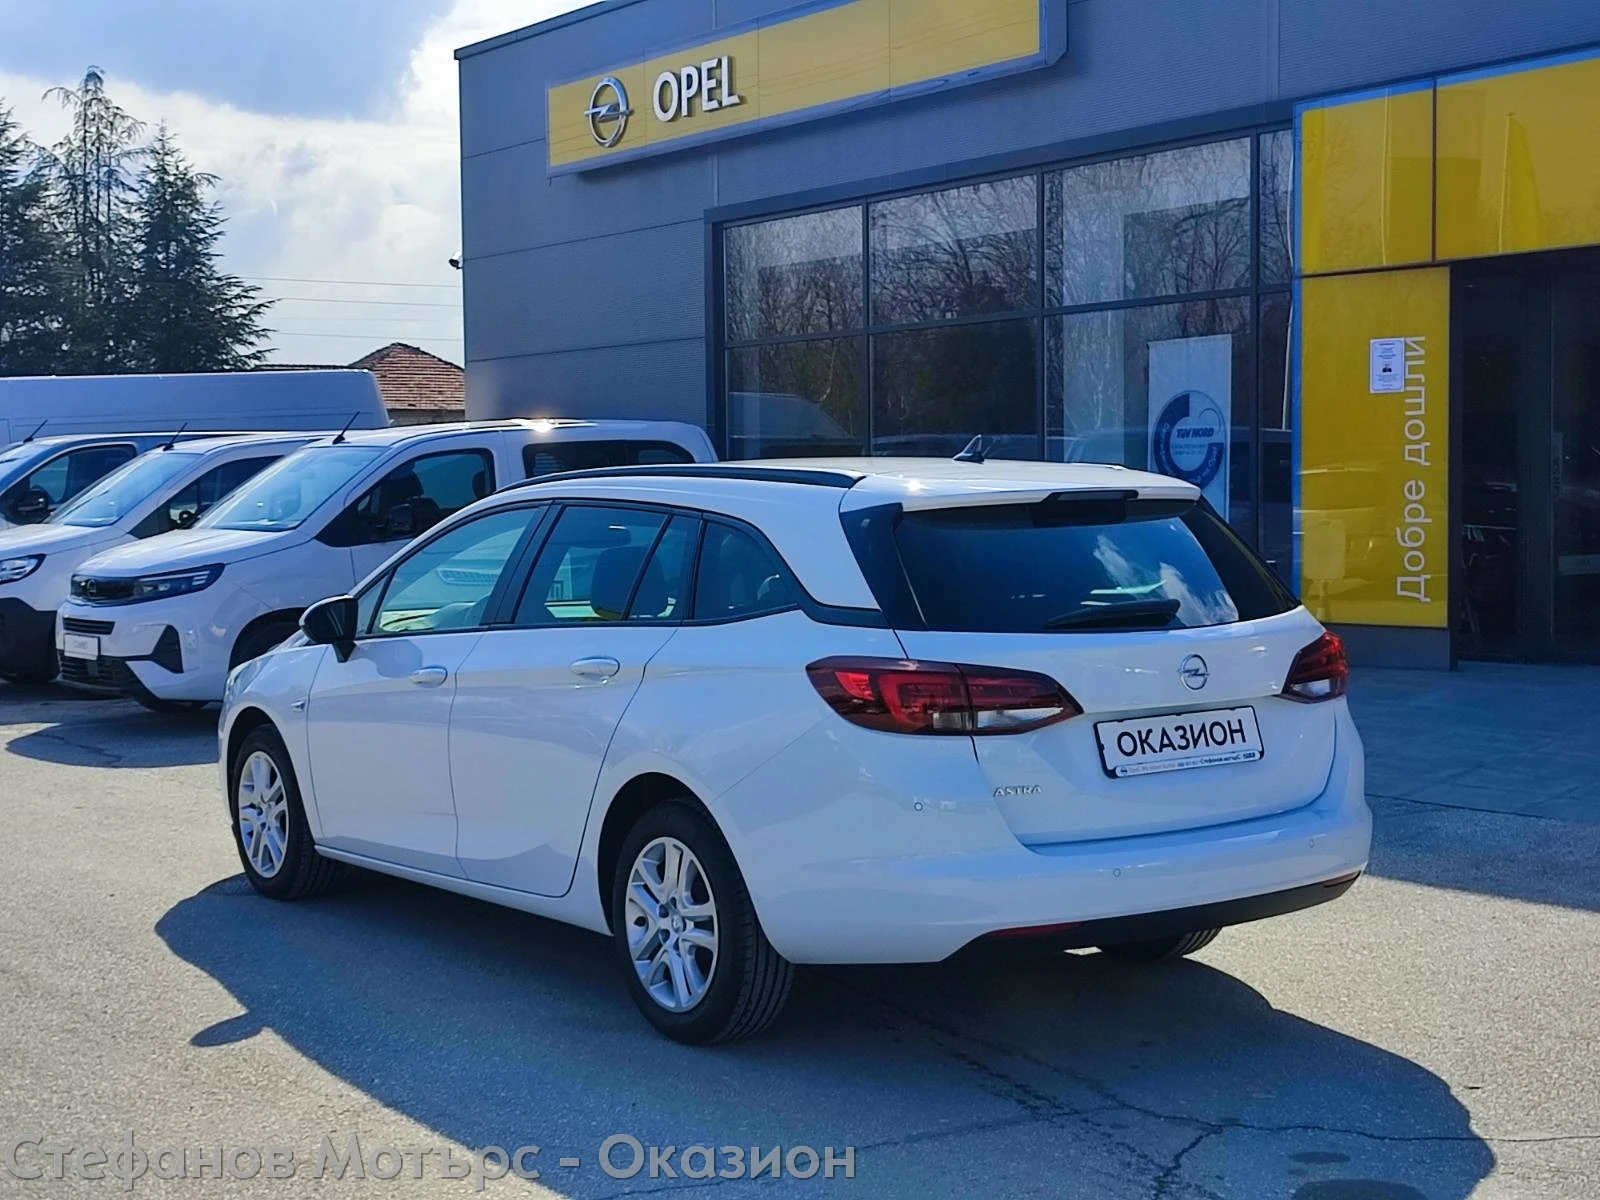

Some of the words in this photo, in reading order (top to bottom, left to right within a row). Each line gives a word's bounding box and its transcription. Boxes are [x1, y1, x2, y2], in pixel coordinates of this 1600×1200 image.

[653, 56, 740, 122] OPEL
[1404, 336, 1431, 466] дошли
[1191, 427, 1214, 438] NORD
[1396, 479, 1432, 603] Добре
[1117, 718, 1246, 757] ОКАЗИОН
[993, 784, 1043, 798] ASTRA
